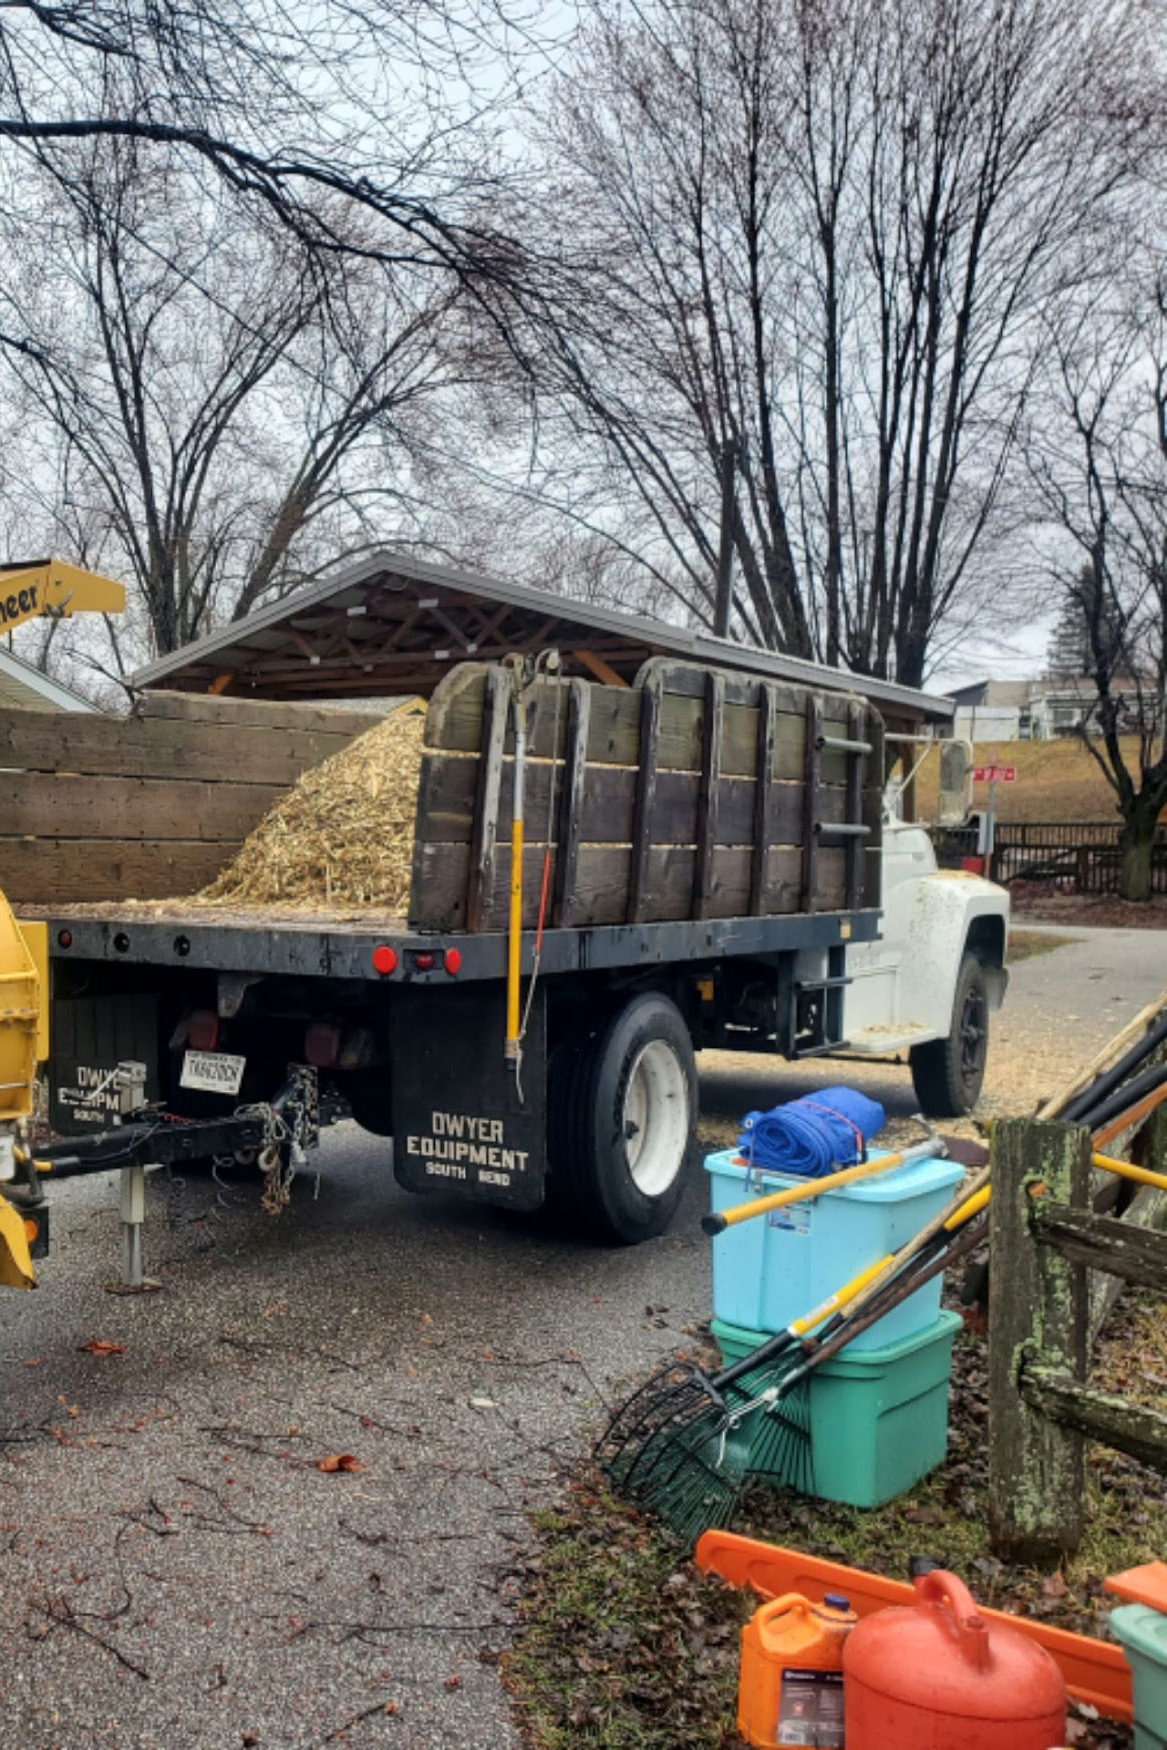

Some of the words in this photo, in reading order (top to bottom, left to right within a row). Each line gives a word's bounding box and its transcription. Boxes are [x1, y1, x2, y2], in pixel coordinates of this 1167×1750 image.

[76, 1066, 122, 1091] DWYE
[432, 1111, 504, 1144] DWYER
[406, 1135, 529, 1172] EQUIPMENT
[425, 1161, 466, 1180] SOUTH
[478, 1169, 510, 1187] BEND
